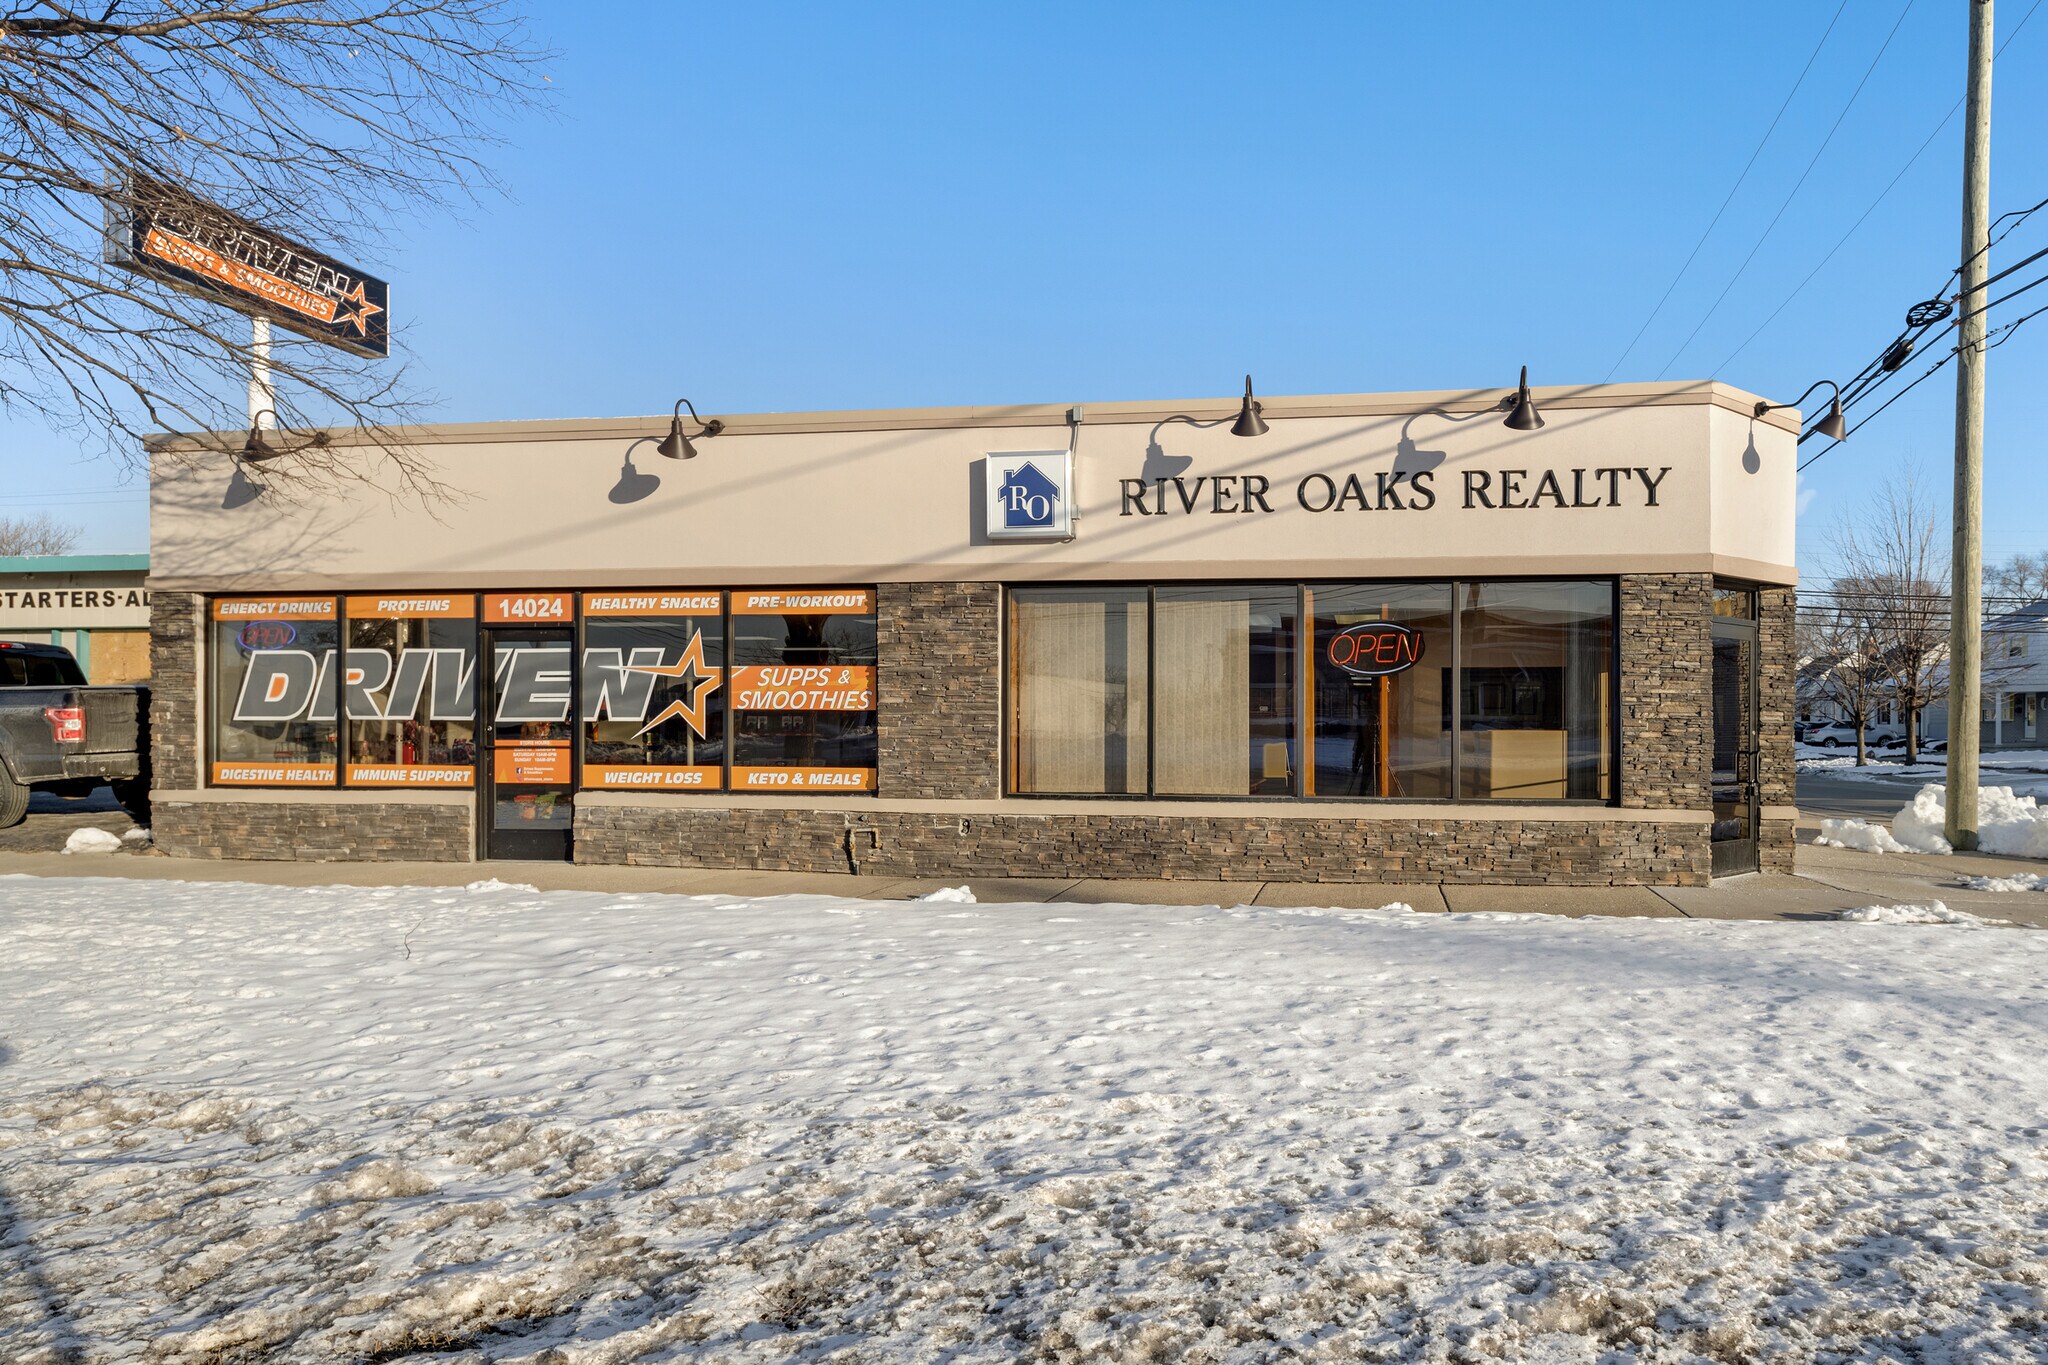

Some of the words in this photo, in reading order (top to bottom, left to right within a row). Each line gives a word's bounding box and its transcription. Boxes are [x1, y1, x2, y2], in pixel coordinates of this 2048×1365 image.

[219, 263, 230, 276] &
[234, 268, 330, 315] SMOOTHIES
[1119, 474, 1275, 516] RIVER
[1296, 470, 1437, 513] OAKS
[1460, 466, 1673, 509] REALTY
[1008, 485, 1051, 521] RO
[220, 602, 276, 614] ENERGY
[278, 601, 332, 614] DRINKS
[377, 599, 450, 612] PROTEINS
[499, 598, 563, 618] 14024
[590, 597, 656, 610] HEALTHY
[660, 596, 720, 609] SNACKS
[747, 594, 866, 608] PRE-WORKOUT
[241, 626, 292, 645] OPEN
[1330, 633, 1421, 665] OPEN
[232, 647, 666, 722] DRIVEN
[757, 667, 831, 687] SUPPS
[837, 669, 851, 685] &
[737, 690, 873, 710] SMOOTHIES
[220, 769, 284, 781] DIGESTIVE
[286, 769, 334, 781] HEALTH
[352, 769, 407, 781] IMMUNE
[409, 770, 471, 782] SUPPORT
[604, 772, 662, 784] WEIGHT
[664, 772, 703, 784] LOSS
[747, 773, 788, 785] KETO
[791, 773, 804, 785] &
[808, 773, 862, 785] MEALS
